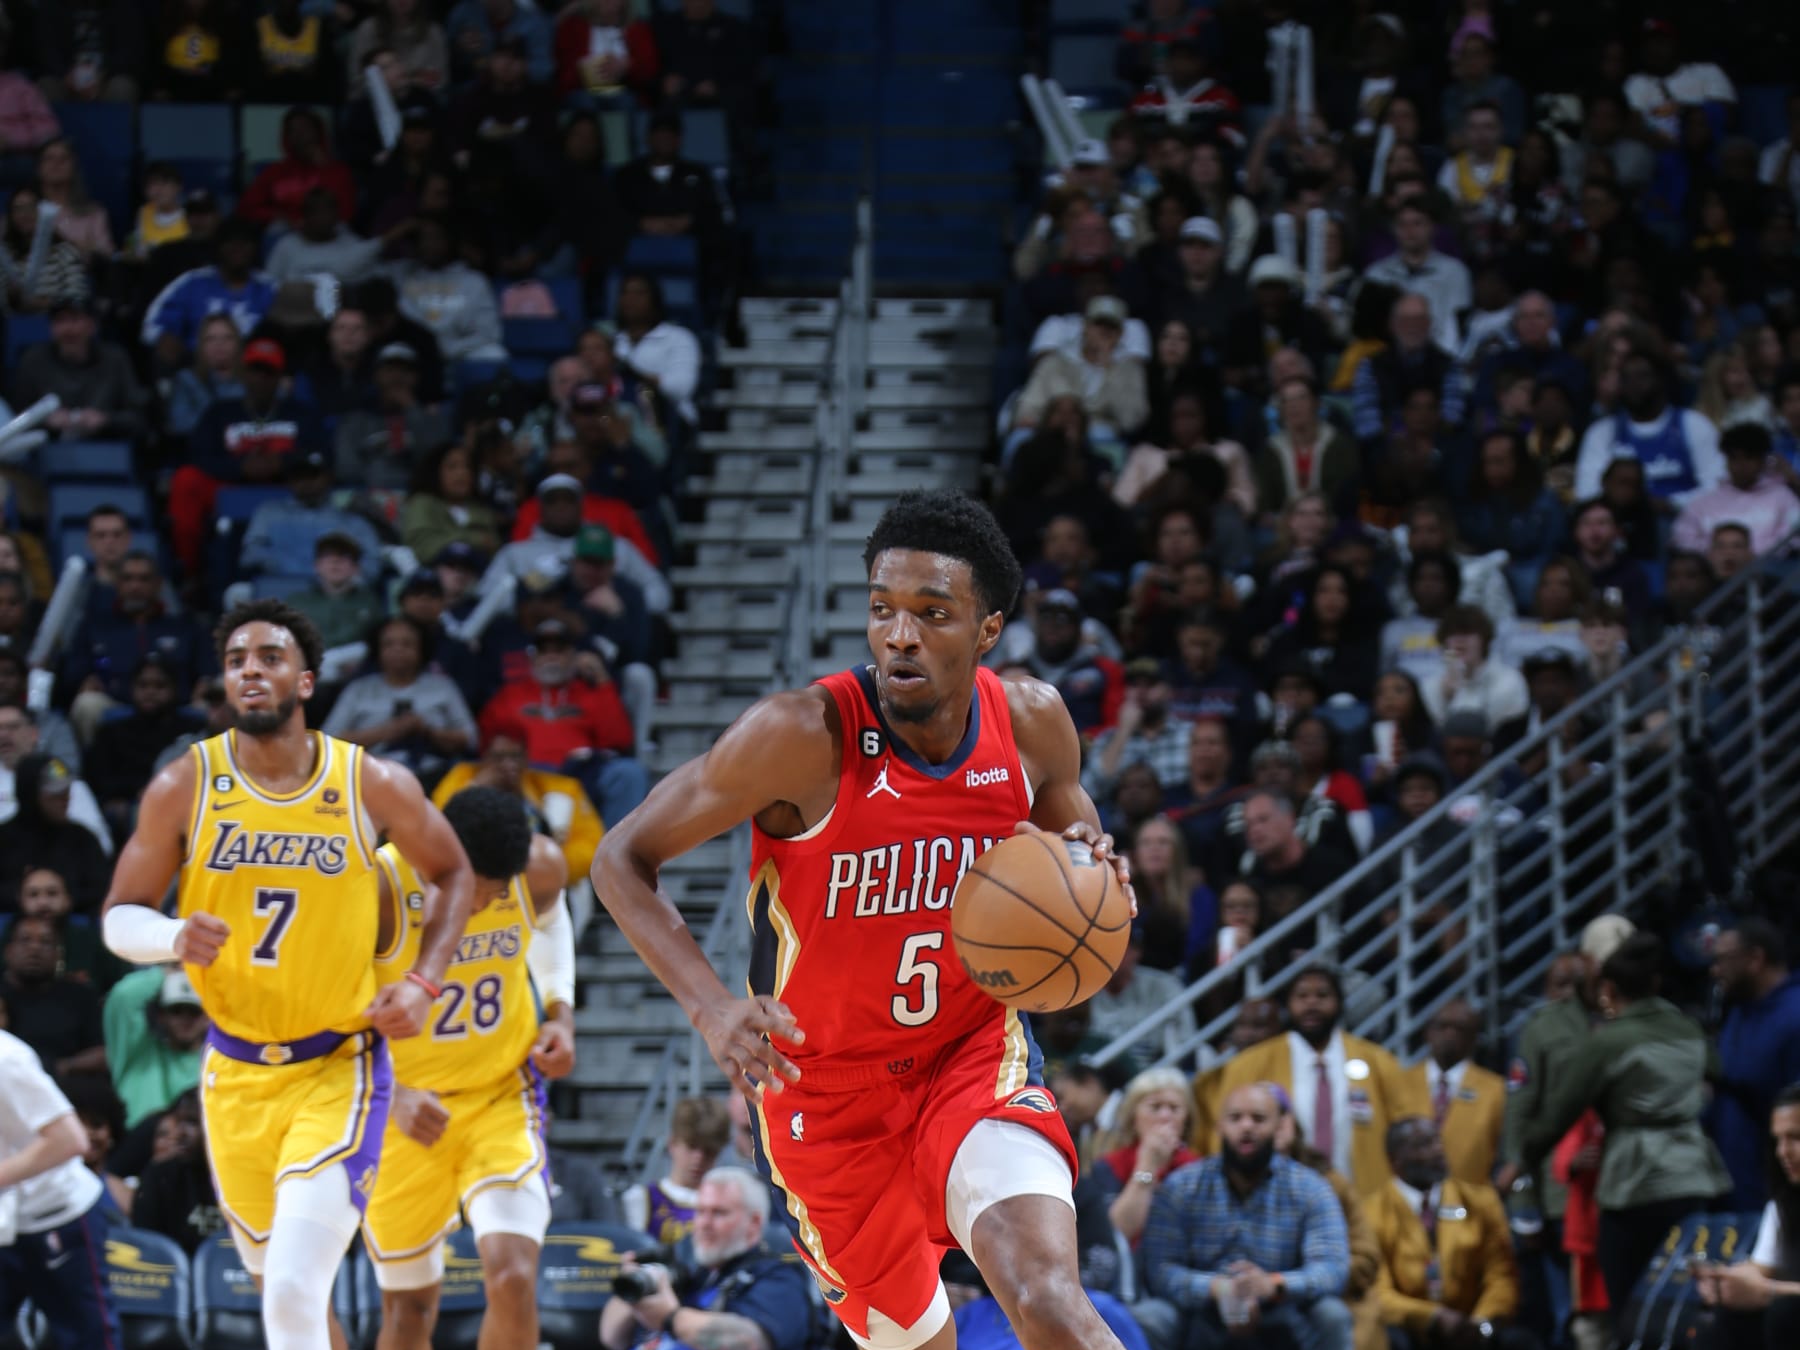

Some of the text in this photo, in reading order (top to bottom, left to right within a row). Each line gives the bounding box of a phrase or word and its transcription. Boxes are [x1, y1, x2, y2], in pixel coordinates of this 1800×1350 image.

[861, 731, 880, 755] 6
[215, 777, 231, 792] 6
[966, 766, 1009, 788] ibotta
[206, 820, 349, 876] LAKERS
[825, 836, 1005, 919] PELICA
[252, 887, 299, 967] 7
[448, 924, 520, 964] KERS
[433, 974, 503, 1040] 28
[891, 931, 944, 1027] 5
